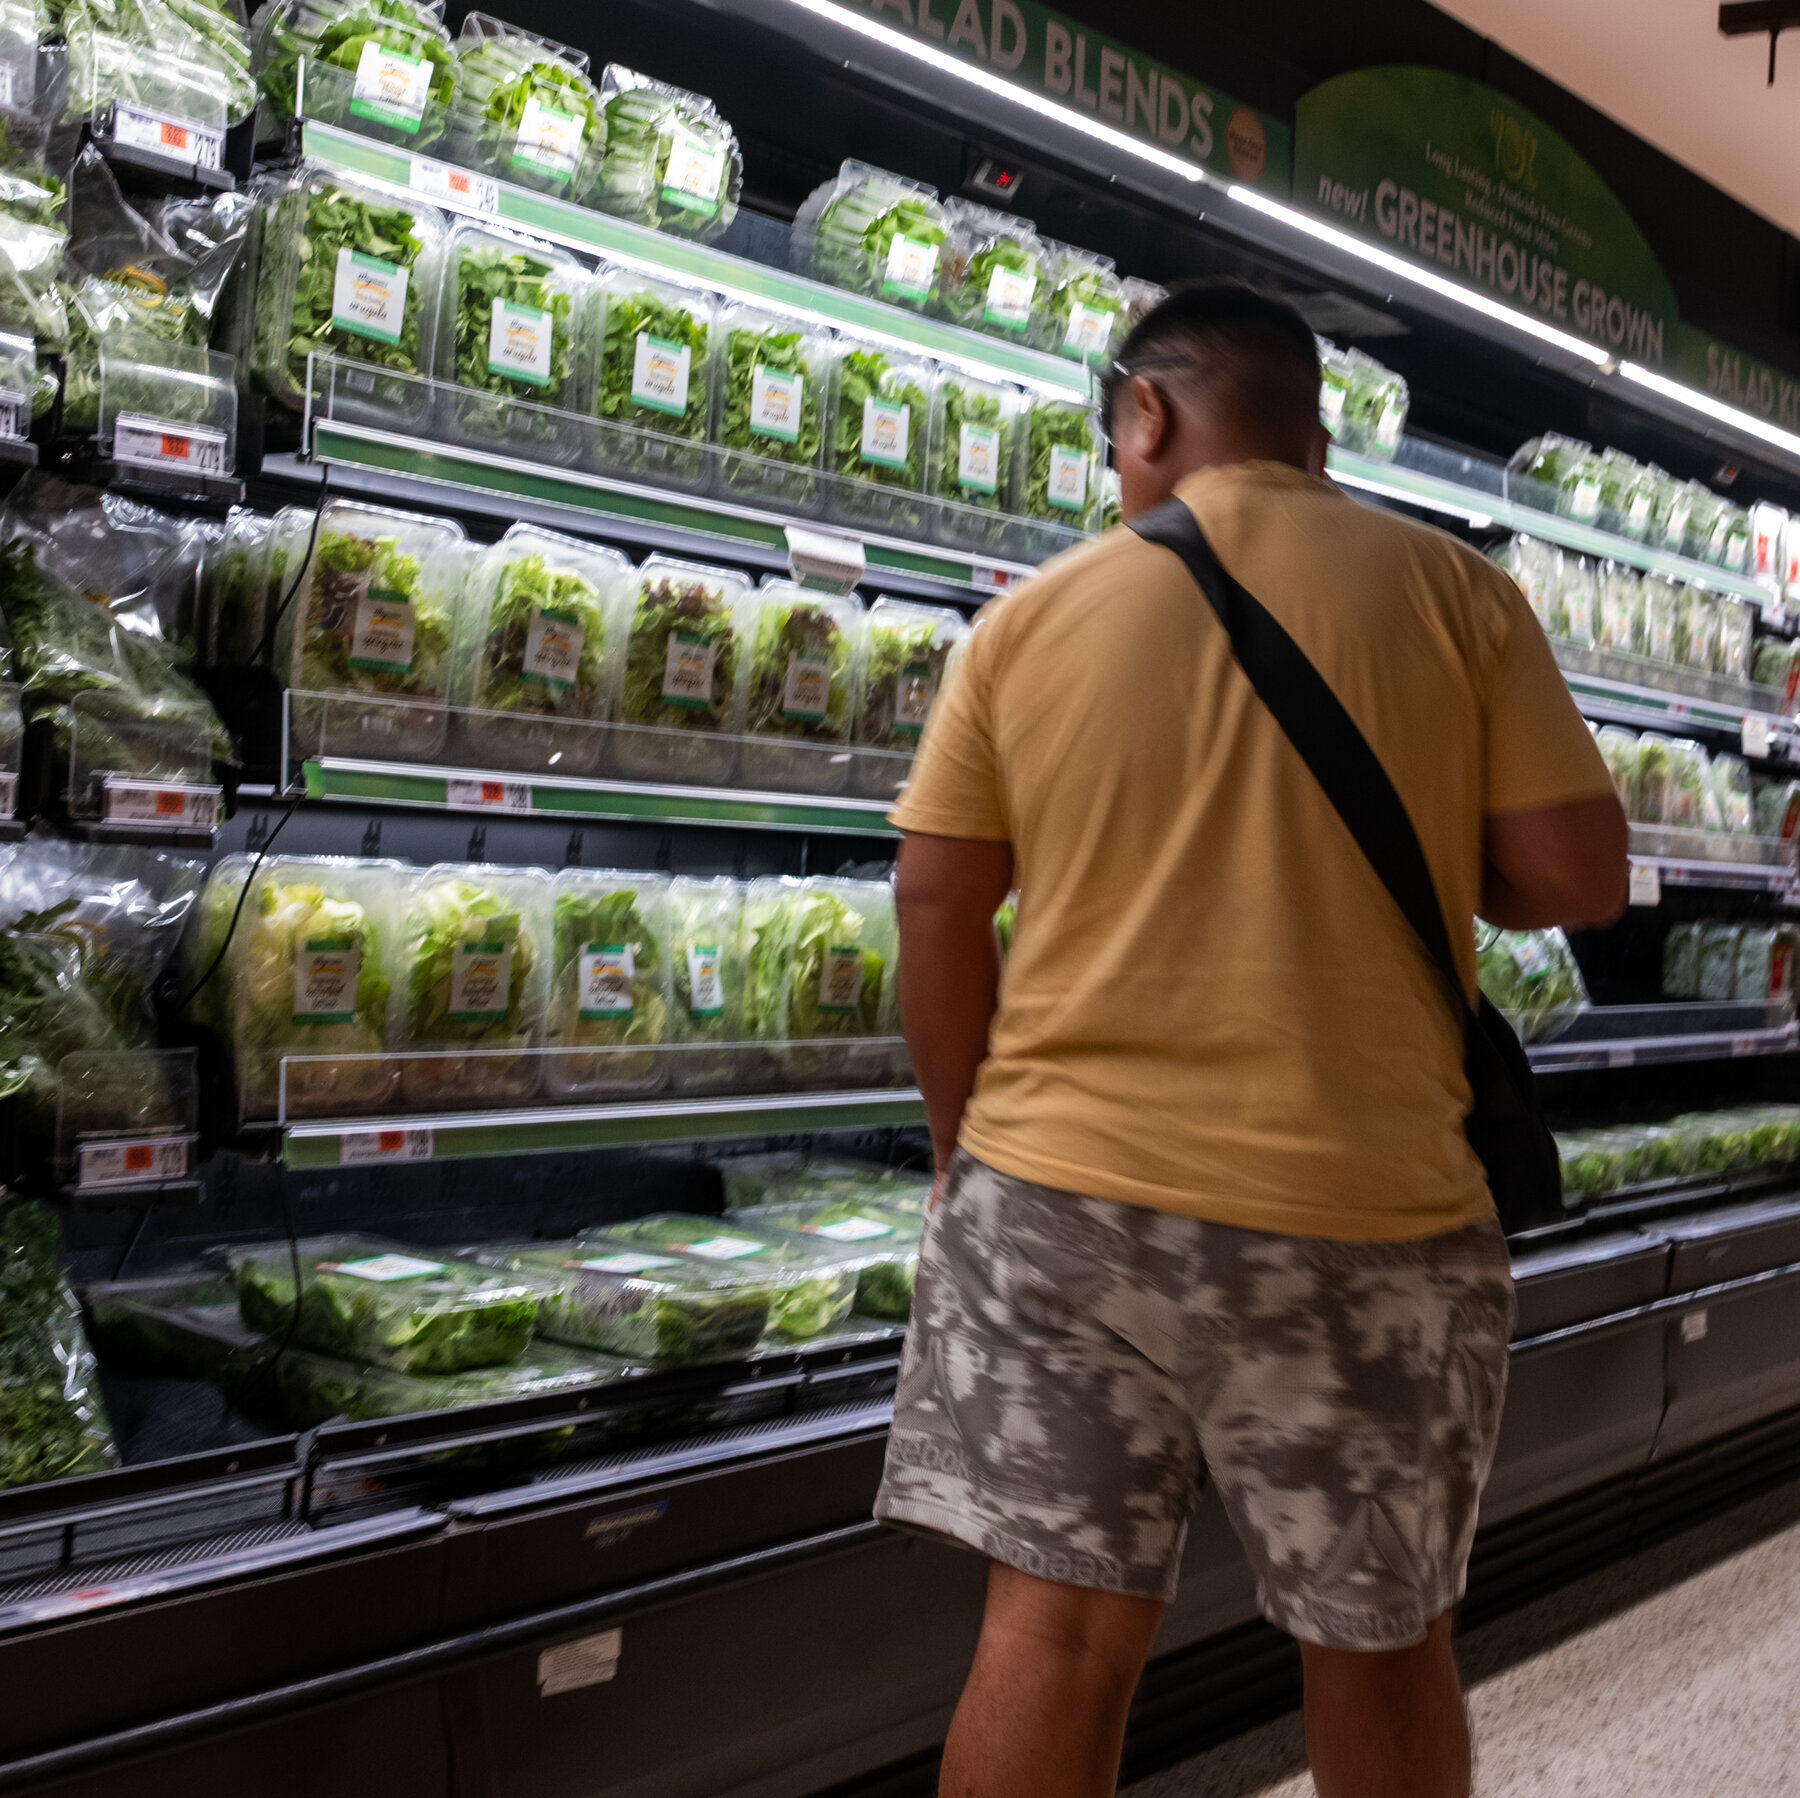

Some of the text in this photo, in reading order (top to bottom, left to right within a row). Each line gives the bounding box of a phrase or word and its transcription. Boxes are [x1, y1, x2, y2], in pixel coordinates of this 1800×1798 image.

[1044, 19, 1214, 159] BLENDS
[1317, 174, 1664, 365] new! GREENHOUSE GROWN
[1706, 342, 1775, 417] SALAD
[889, 1430, 971, 1481] eebok
